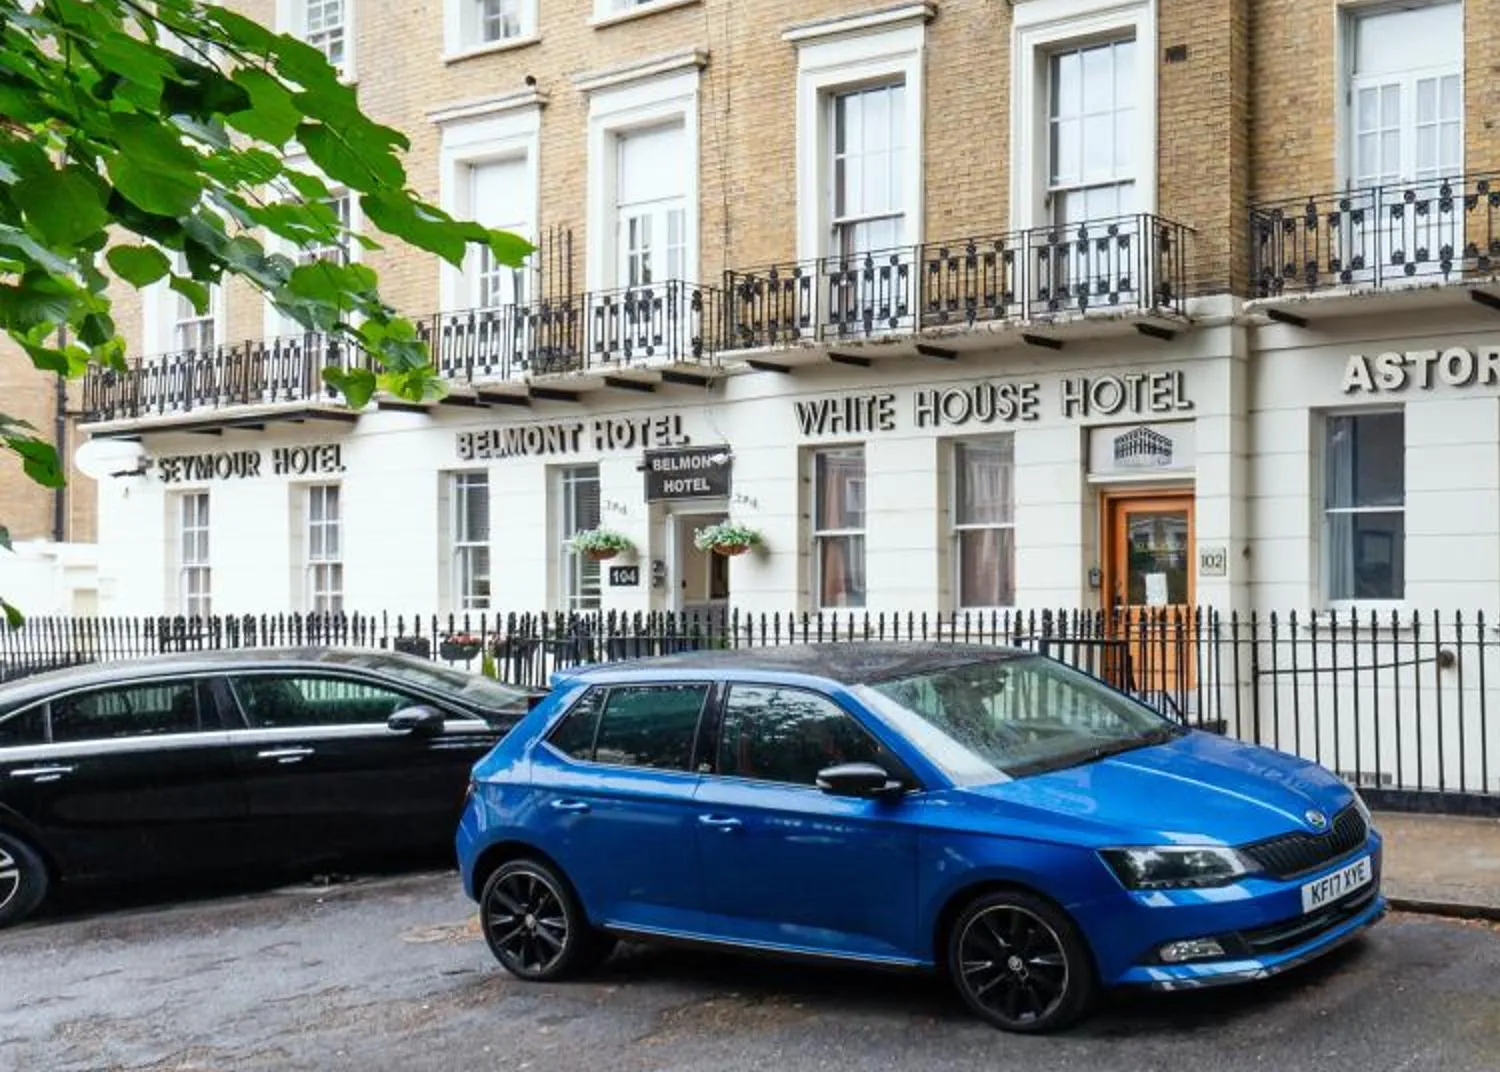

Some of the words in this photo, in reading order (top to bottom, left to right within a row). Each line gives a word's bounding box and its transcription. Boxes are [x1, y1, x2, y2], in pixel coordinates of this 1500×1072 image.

[794, 394, 895, 436] WHITE
[914, 383, 1040, 428] HOUSE
[1061, 370, 1195, 418] HOTEL
[456, 424, 583, 460] BELMONT
[595, 415, 690, 450] HOTEL
[158, 450, 261, 482] SEYMOUR
[273, 443, 347, 475] HOTEL
[652, 454, 724, 471] BELMON
[663, 477, 711, 493] HOTEL
[1201, 553, 1223, 569] 102
[613, 569, 636, 583] 104
[1311, 874, 1340, 904] KF17
[1343, 860, 1365, 889] XYE
